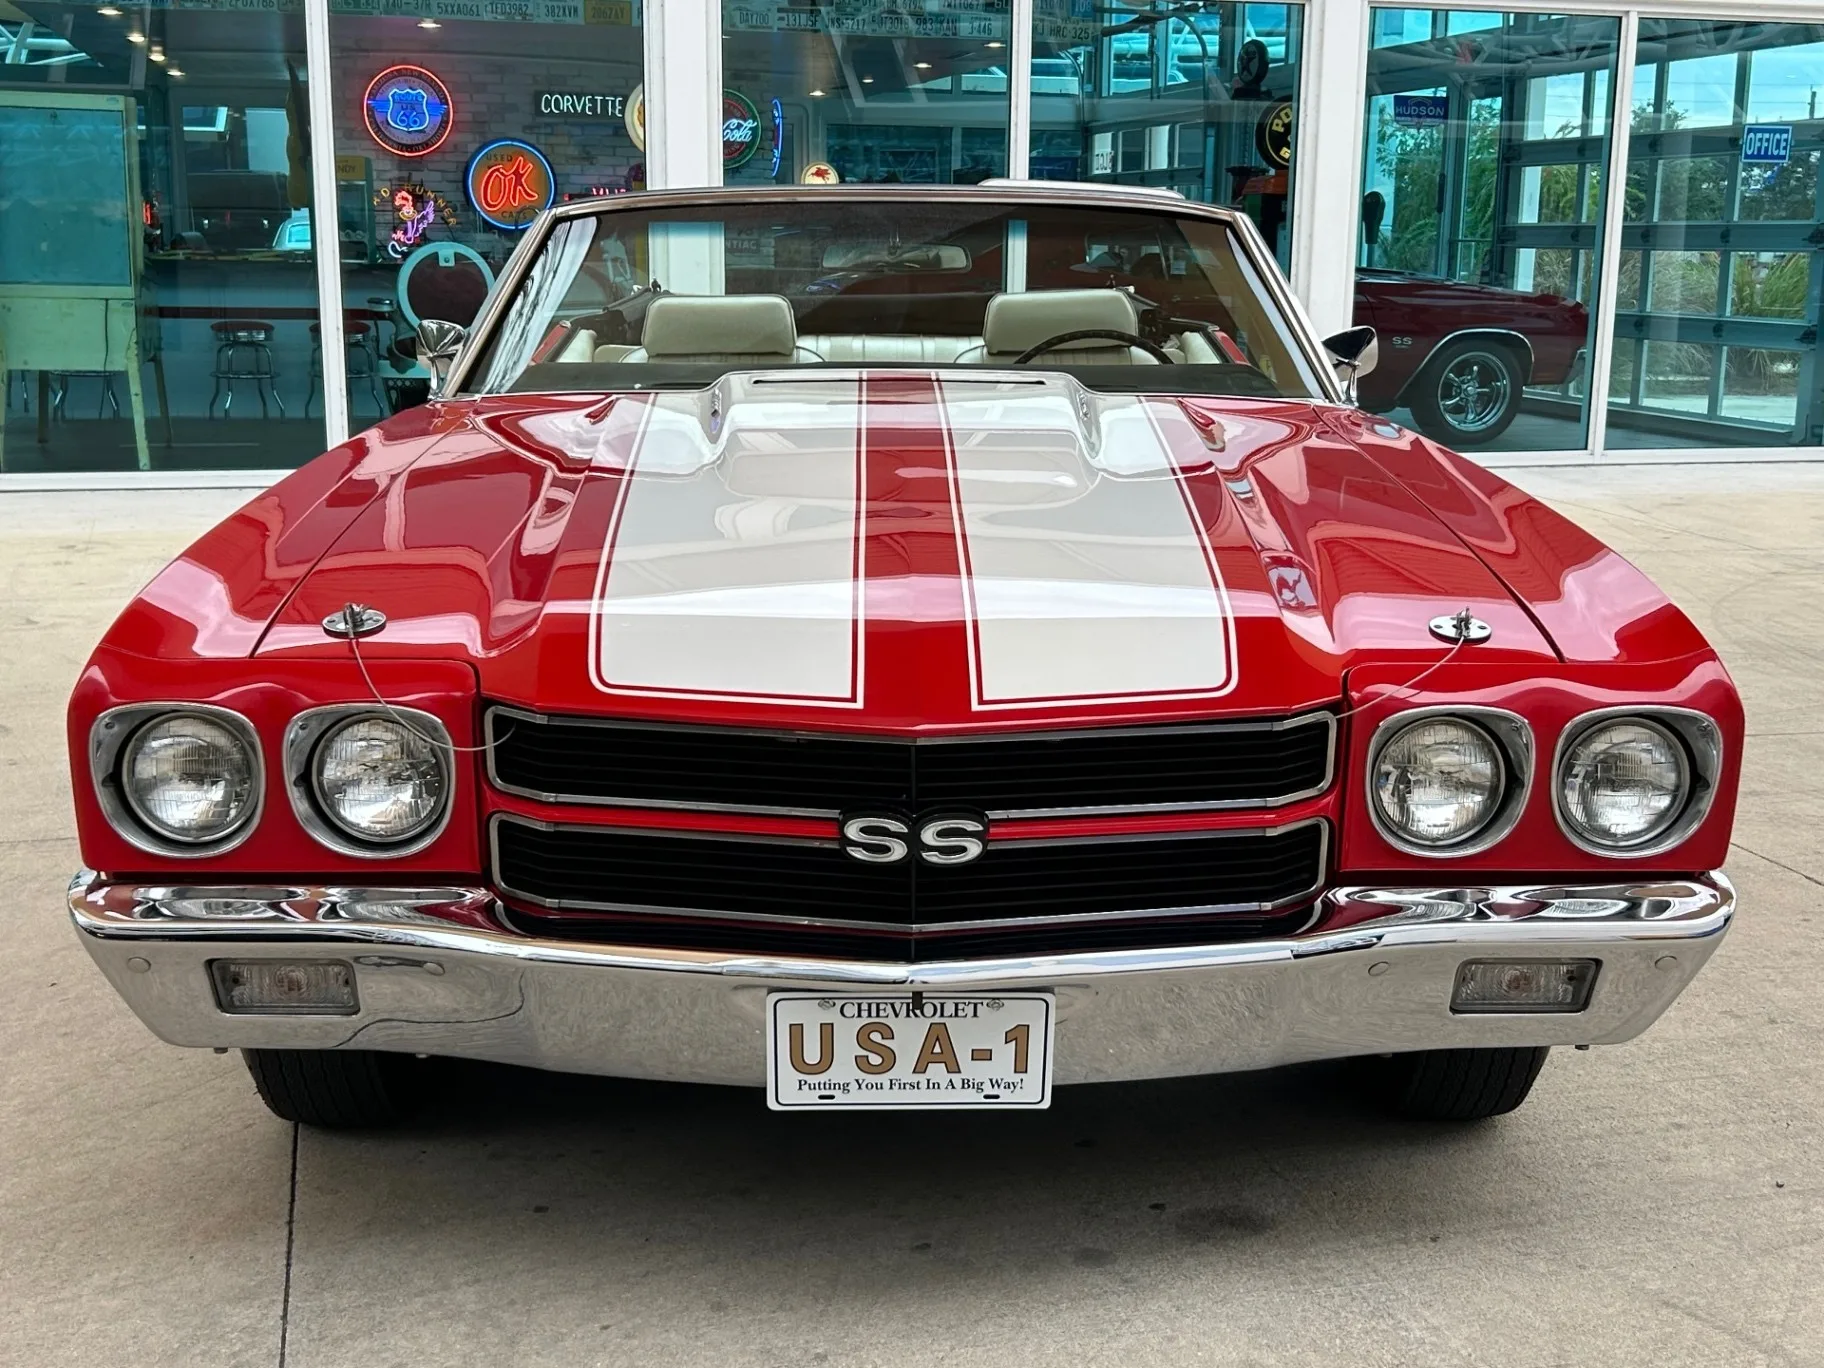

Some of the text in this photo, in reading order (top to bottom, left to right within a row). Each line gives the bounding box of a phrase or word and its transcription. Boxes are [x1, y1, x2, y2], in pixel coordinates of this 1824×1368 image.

[436, 2, 481, 17] 5XXA061
[394, 93, 423, 102] ROUTE
[541, 93, 624, 118] CORVETTE
[397, 111, 420, 127] 66
[1395, 105, 1445, 117] HUDSON
[1745, 132, 1789, 156] OFFICE
[486, 153, 512, 162] USED
[481, 156, 538, 211] OK
[404, 183, 457, 226] RUNNER
[1391, 336, 1413, 345] SS
[843, 817, 985, 865] SS
[797, 1077, 1024, 1094] Putting You First In A Big Way!
